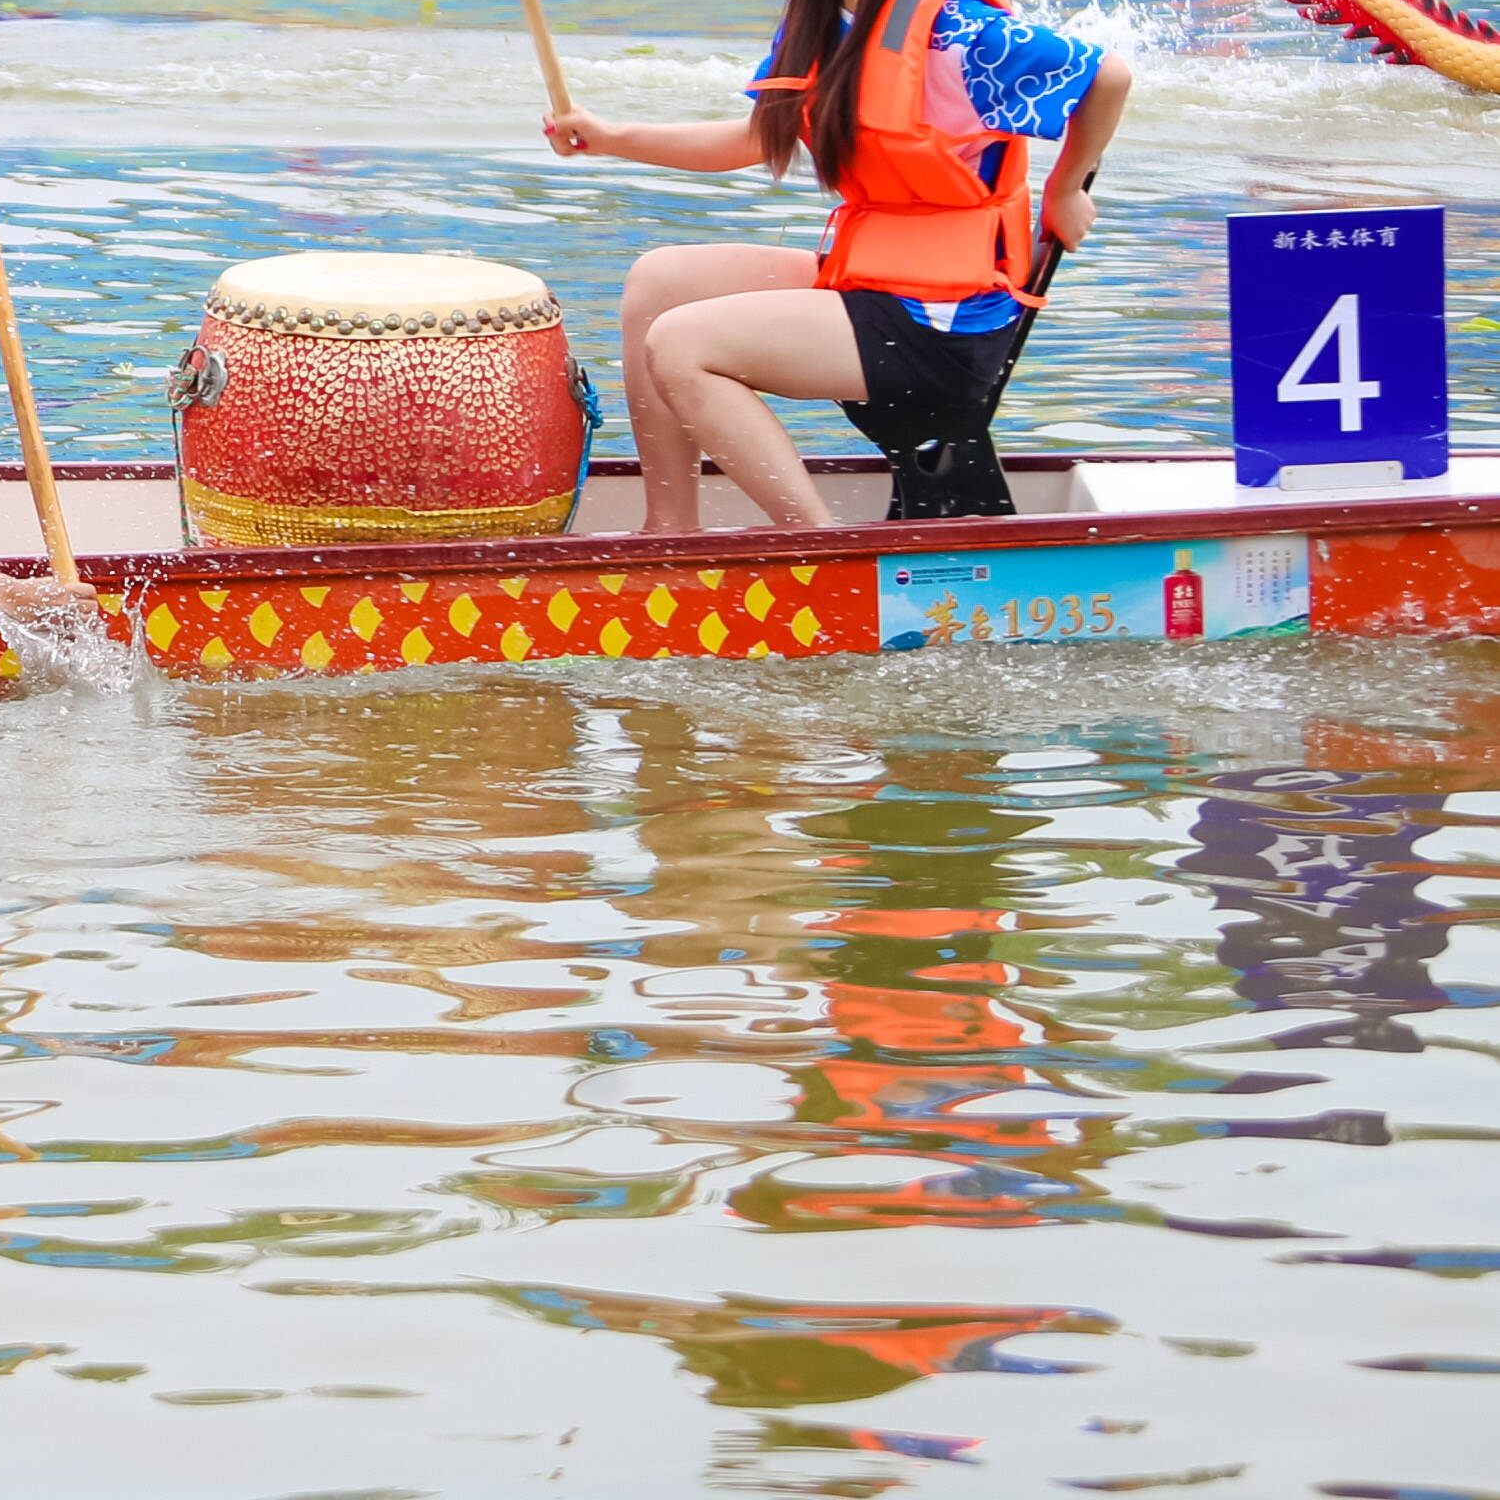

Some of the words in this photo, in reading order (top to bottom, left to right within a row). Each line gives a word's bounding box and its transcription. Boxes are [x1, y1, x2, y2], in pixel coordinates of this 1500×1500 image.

[1272, 226, 1400, 250] 新未来体育
[1277, 293, 1381, 432] 4
[922, 589, 1115, 646] 茅台1935
